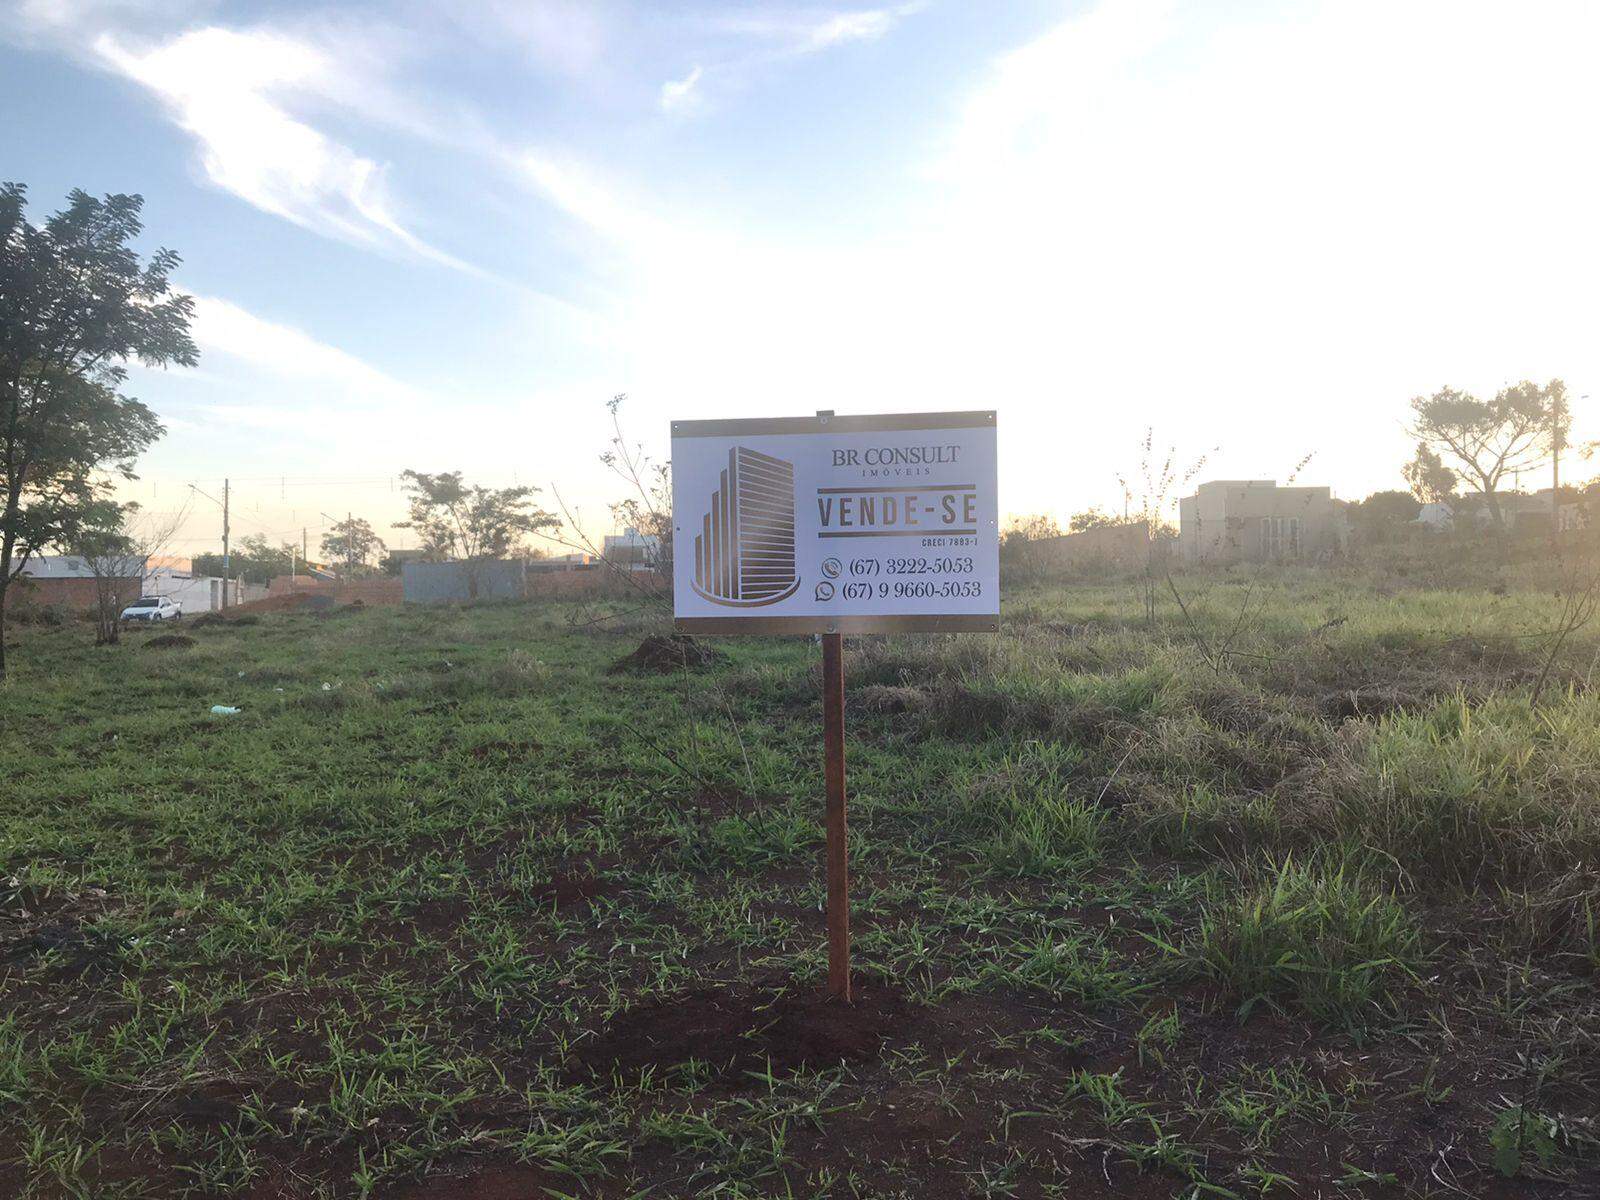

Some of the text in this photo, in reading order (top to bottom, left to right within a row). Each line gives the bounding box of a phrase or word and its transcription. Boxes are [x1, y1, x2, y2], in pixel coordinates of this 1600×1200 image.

[832, 445, 961, 467] BR CONSULT
[862, 467, 930, 477] IMÓVEIS
[818, 494, 977, 527] VENDE-SE
[921, 538, 946, 547] CRECI
[850, 557, 974, 577] (67) 3222-5053
[842, 581, 982, 601] (67) 9 9660-5053
